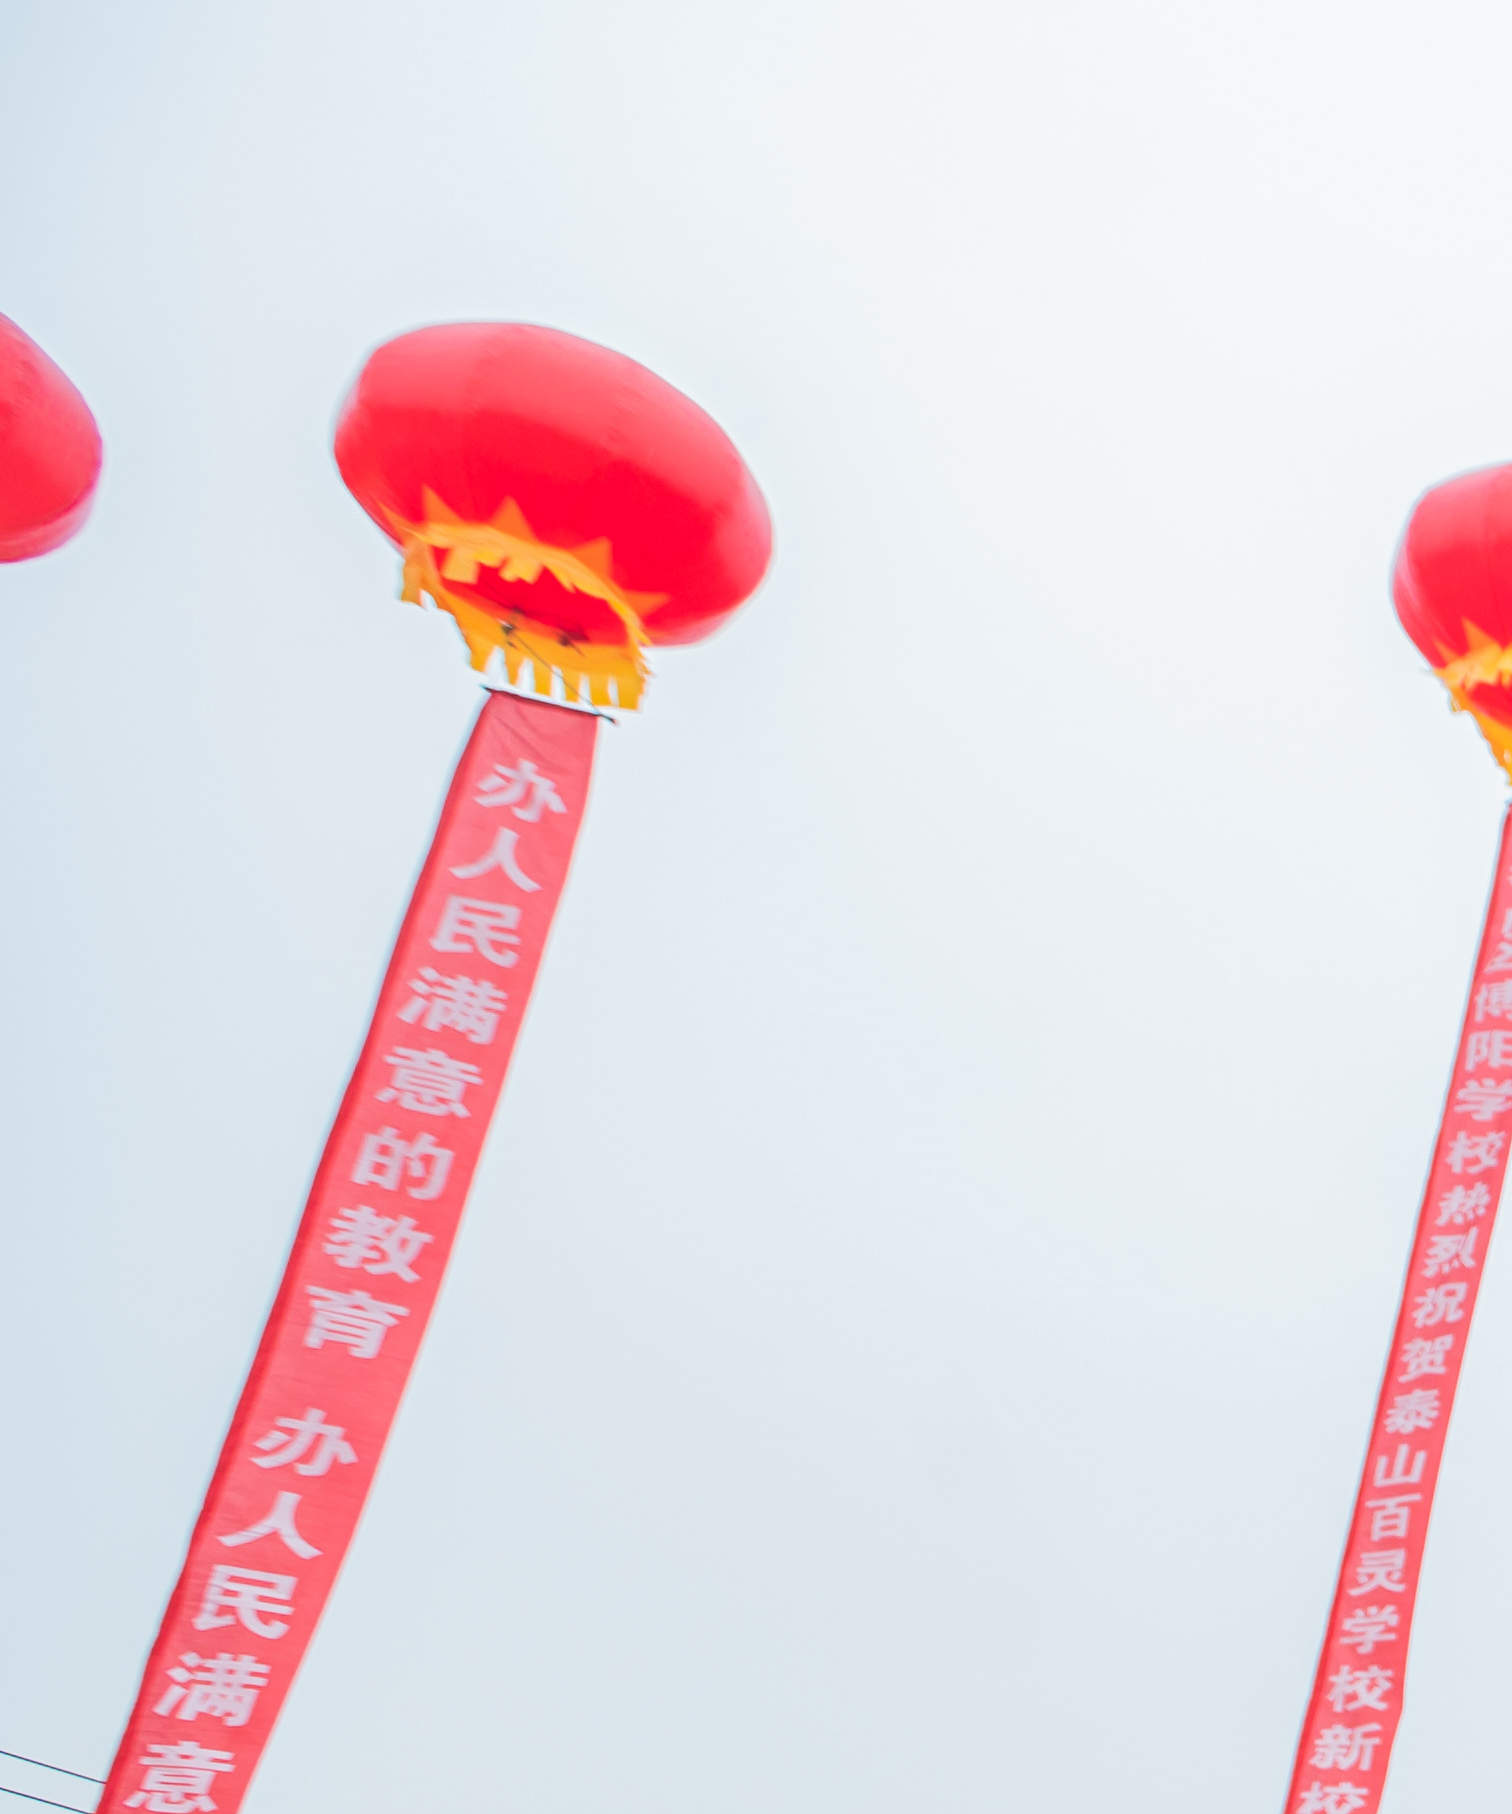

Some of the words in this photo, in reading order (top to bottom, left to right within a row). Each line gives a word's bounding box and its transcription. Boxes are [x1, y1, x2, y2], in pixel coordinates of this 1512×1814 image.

[303, 758, 567, 1359] 办人民满意的教育
